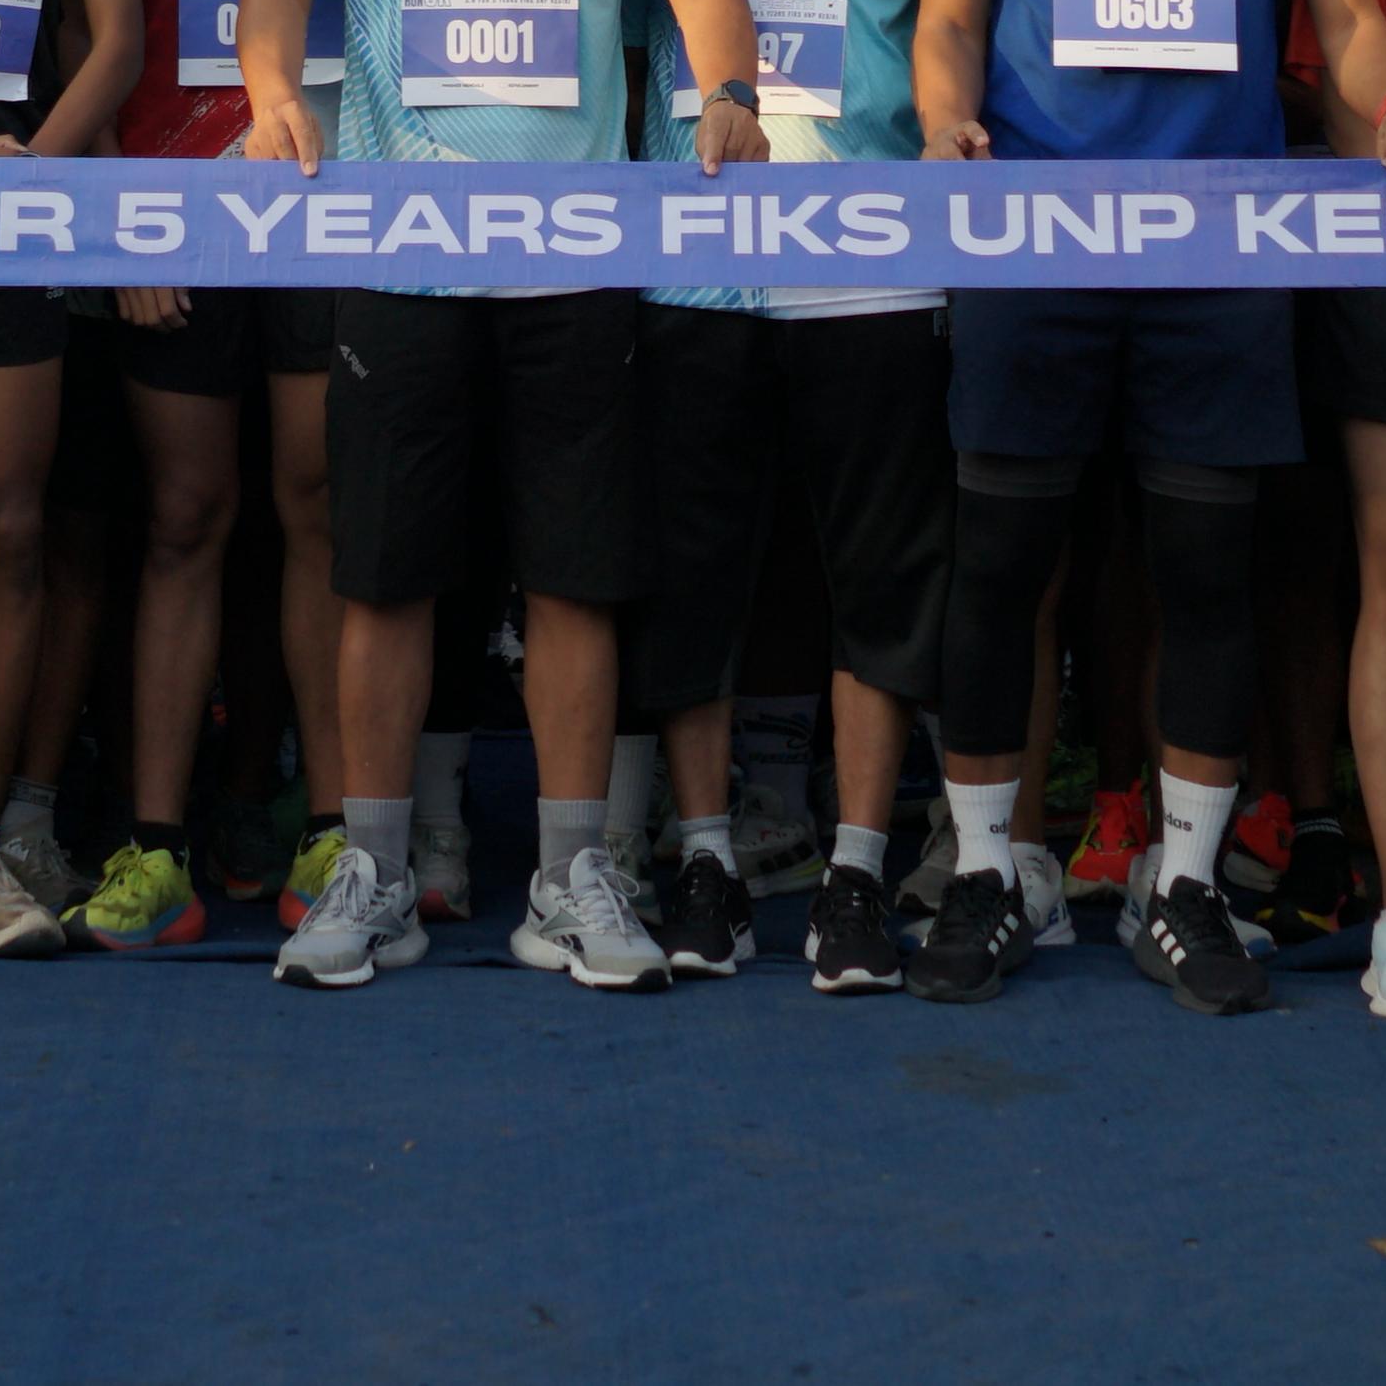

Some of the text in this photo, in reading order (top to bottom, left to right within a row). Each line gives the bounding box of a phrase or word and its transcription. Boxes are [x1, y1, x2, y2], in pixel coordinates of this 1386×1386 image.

[446, 19, 534, 64] 0001
[757, 32, 804, 74] 97
[115, 192, 185, 254] 5
[216, 191, 623, 255] YEARS
[660, 191, 911, 255] FIKS
[949, 193, 1197, 255] UNP
